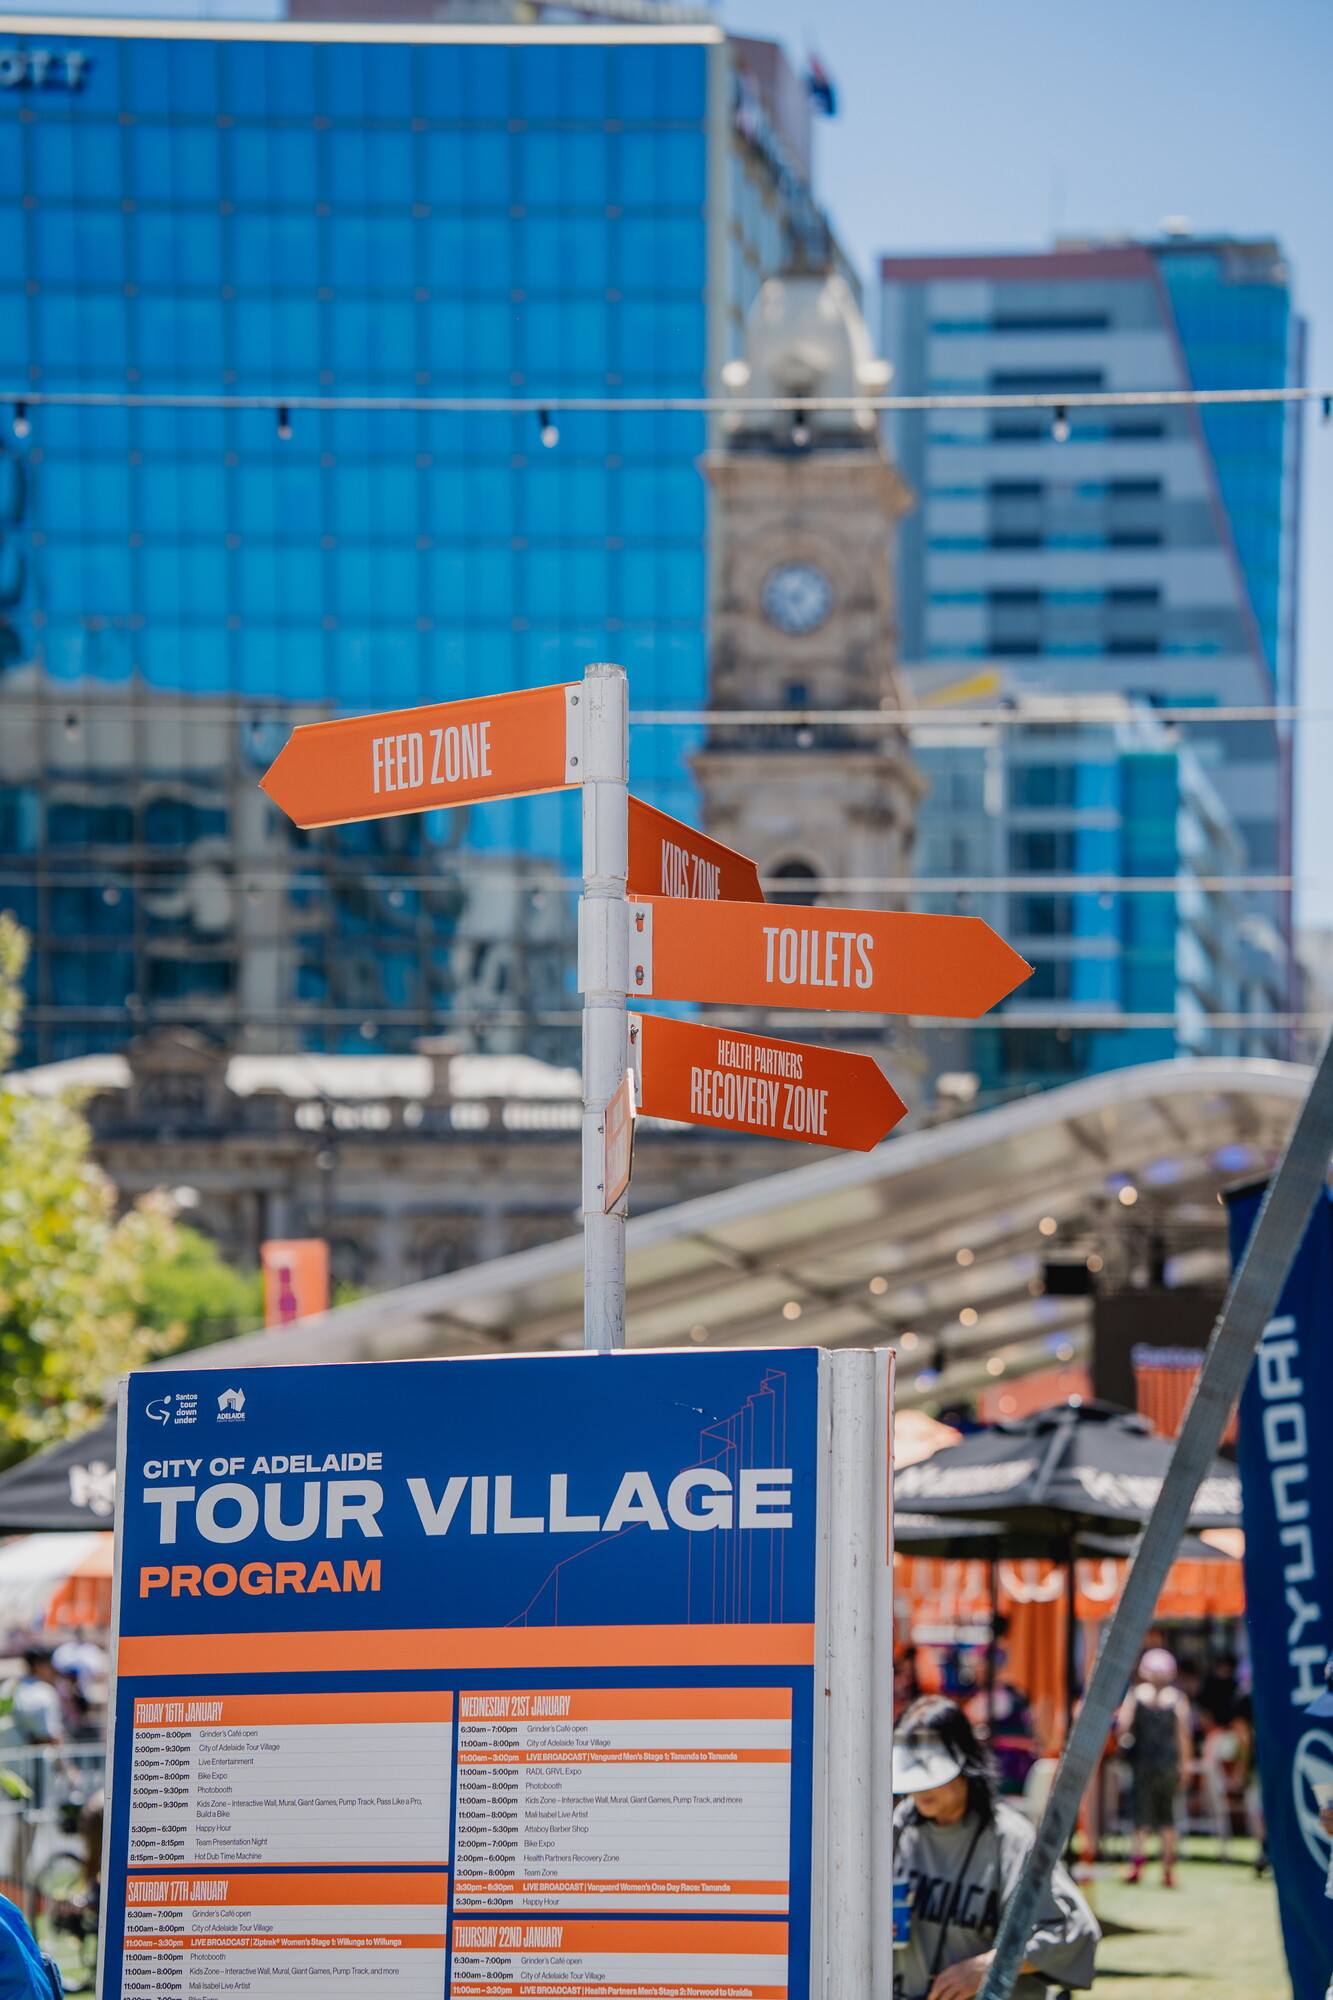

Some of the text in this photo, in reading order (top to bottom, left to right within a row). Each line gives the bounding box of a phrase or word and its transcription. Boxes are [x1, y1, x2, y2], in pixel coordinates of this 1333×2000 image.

[373, 721, 492, 793] FEED ZONE
[661, 838, 720, 900] KIDS ZONE
[763, 927, 873, 988] TOILETS
[718, 1040, 802, 1079] HEALTH PARTNERS
[691, 1066, 828, 1136] RECOVERY ZONE
[176, 1408, 197, 1416] down
[143, 1452, 382, 1479] CITY OF ADELAIDE
[144, 1479, 384, 1544] TOUR
[406, 1468, 793, 1536] VILLAGE
[1258, 1315, 1327, 1706] HYUNDAI
[140, 1559, 381, 1598] PROGRAM
[136, 1702, 223, 1723] FRIDAY 16TH JANUARY
[461, 1696, 571, 1717] WEDNESDAY 21ST JANUARY
[556, 1724, 571, 1732] Café
[526, 1739, 540, 1748] City
[591, 1739, 610, 1747] Village
[565, 1768, 582, 1776] Expo
[315, 1798, 338, 1806] Games,
[339, 1798, 356, 1806] Pump
[358, 1798, 376, 1806] Track,
[410, 1798, 422, 1806] Pro,
[196, 1825, 216, 1833] Happy
[524, 1825, 549, 1834] Attaboy
[572, 1825, 589, 1834] Shop
[212, 1838, 251, 1846] Presentation
[252, 1838, 267, 1846] Night
[545, 1854, 572, 1862] Partners
[573, 1855, 602, 1863] Recovery
[128, 1881, 228, 1902] SATURDAY 17TH JANUARY
[523, 1898, 543, 1906] Happy
[192, 1910, 219, 1918] Grinder's
[455, 1927, 563, 1948] THURSDAY 22ND JANUARY
